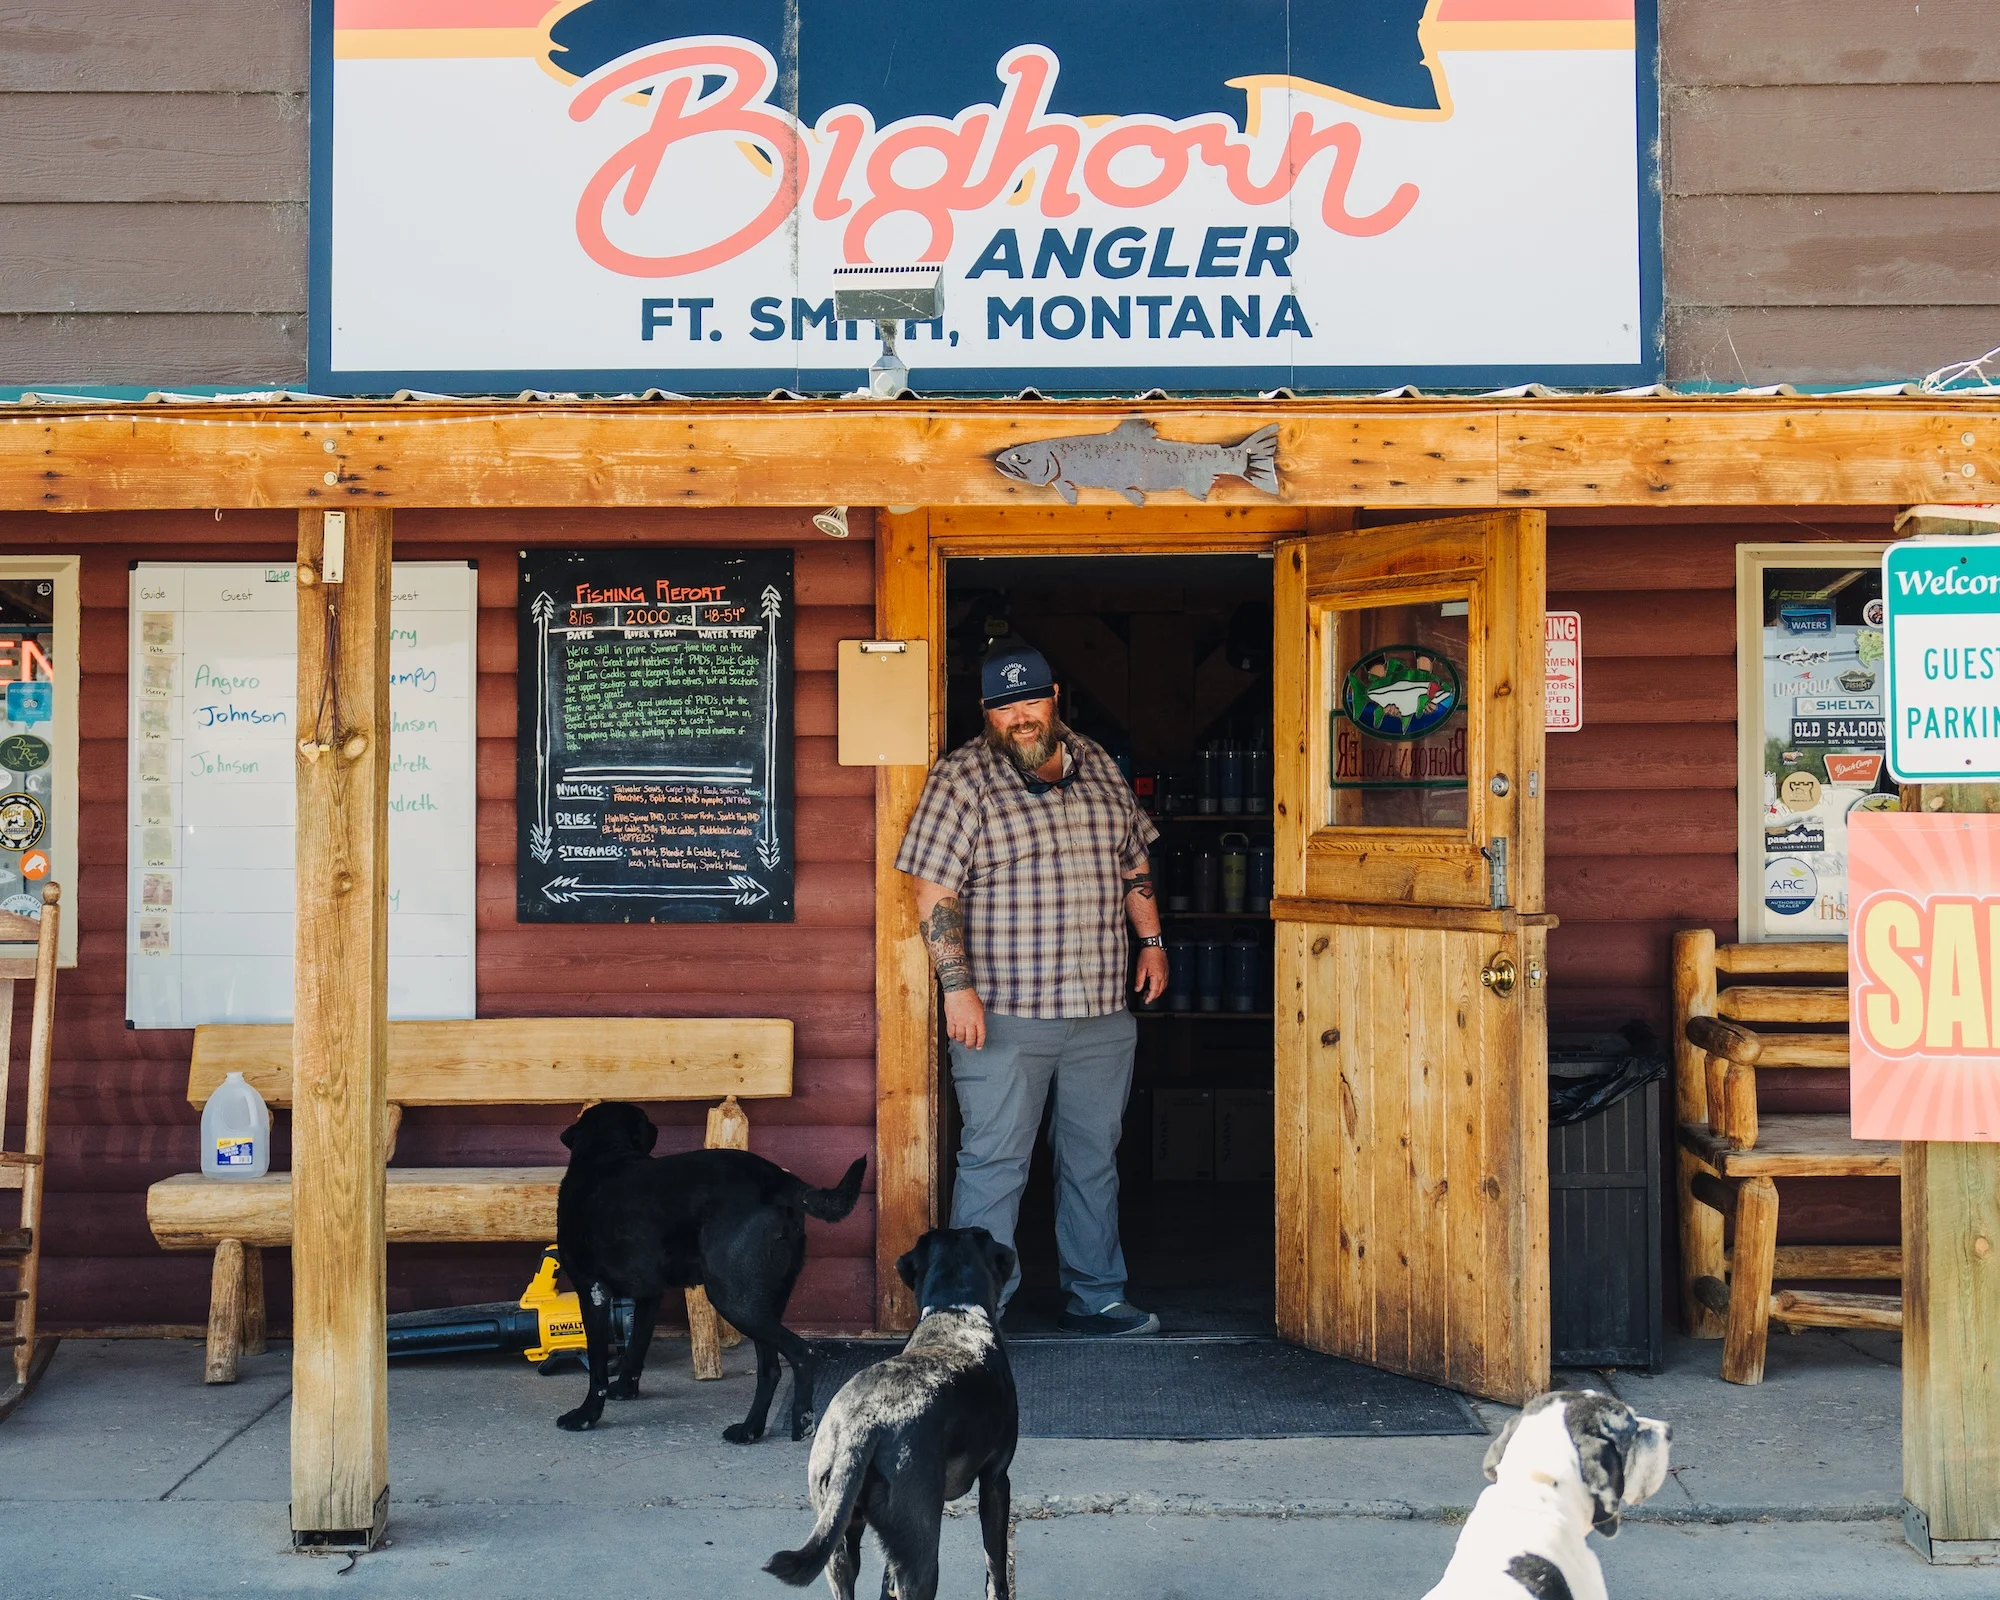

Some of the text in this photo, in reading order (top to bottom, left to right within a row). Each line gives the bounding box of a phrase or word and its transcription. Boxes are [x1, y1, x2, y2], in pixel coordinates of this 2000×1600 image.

[569, 45, 1419, 277] Bighorn
[966, 226, 1301, 277] ANGLER
[641, 297, 723, 341] FT.
[987, 295, 1313, 338] MONTANA
[266, 570, 290, 582] Date
[141, 587, 252, 601] Guide Guest
[656, 580, 726, 604] REPORT
[569, 610, 593, 625] 8/15
[626, 609, 670, 624] 2000
[705, 607, 745, 622] 48-54°
[390, 630, 416, 647] rry
[567, 631, 594, 640] DATE
[624, 630, 676, 639] RIVER FLOW
[698, 630, 757, 639] WATER TEMP
[566, 646, 589, 657] We're
[614, 646, 622, 654] in
[626, 646, 646, 657] prime
[684, 641, 699, 652] time
[702, 643, 716, 652] here
[730, 643, 743, 652] the
[602, 656, 624, 667] Great
[675, 653, 683, 664] of
[716, 655, 736, 665] Black
[1545, 658, 1574, 666] RMEN
[1924, 647, 2000, 680] GUES
[567, 672, 580, 682] and
[1000, 663, 1027, 676] BIGHORN
[195, 664, 260, 694] Angero
[390, 667, 436, 692] empy
[706, 676, 717, 684] but
[730, 677, 758, 686] sections
[1776, 679, 1835, 697] UMPQUA
[1816, 701, 1874, 710] SHELTA
[198, 704, 286, 726] Johnson
[393, 712, 437, 732] hnson
[1794, 721, 1885, 737] OLD SALOON
[191, 751, 258, 776] Johnson
[390, 754, 431, 772] dreth
[556, 783, 609, 796] NYMPHS:
[388, 794, 438, 811] ndreth
[556, 812, 596, 825] DRIES:
[558, 845, 627, 858] STREAMERS:
[1770, 880, 1804, 889] ARC
[1820, 894, 1848, 920] fis
